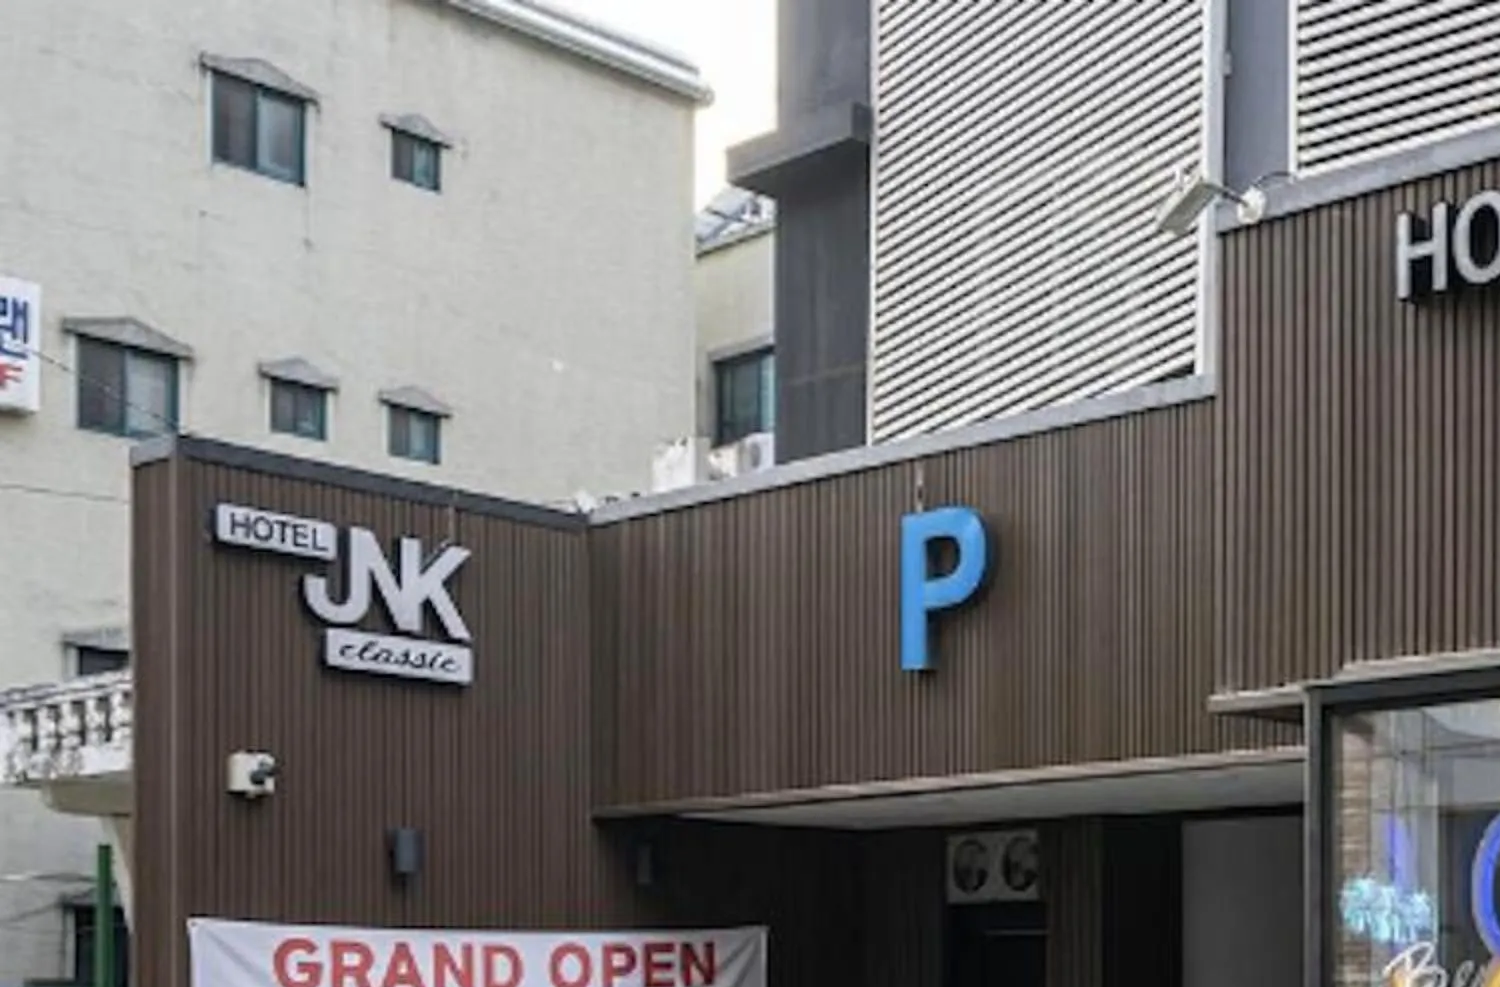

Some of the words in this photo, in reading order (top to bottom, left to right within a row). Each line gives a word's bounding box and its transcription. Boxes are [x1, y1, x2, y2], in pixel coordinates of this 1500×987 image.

[229, 511, 330, 552] HOTEL
[303, 525, 473, 642] JNK
[901, 502, 988, 671] P
[337, 640, 462, 674] classic
